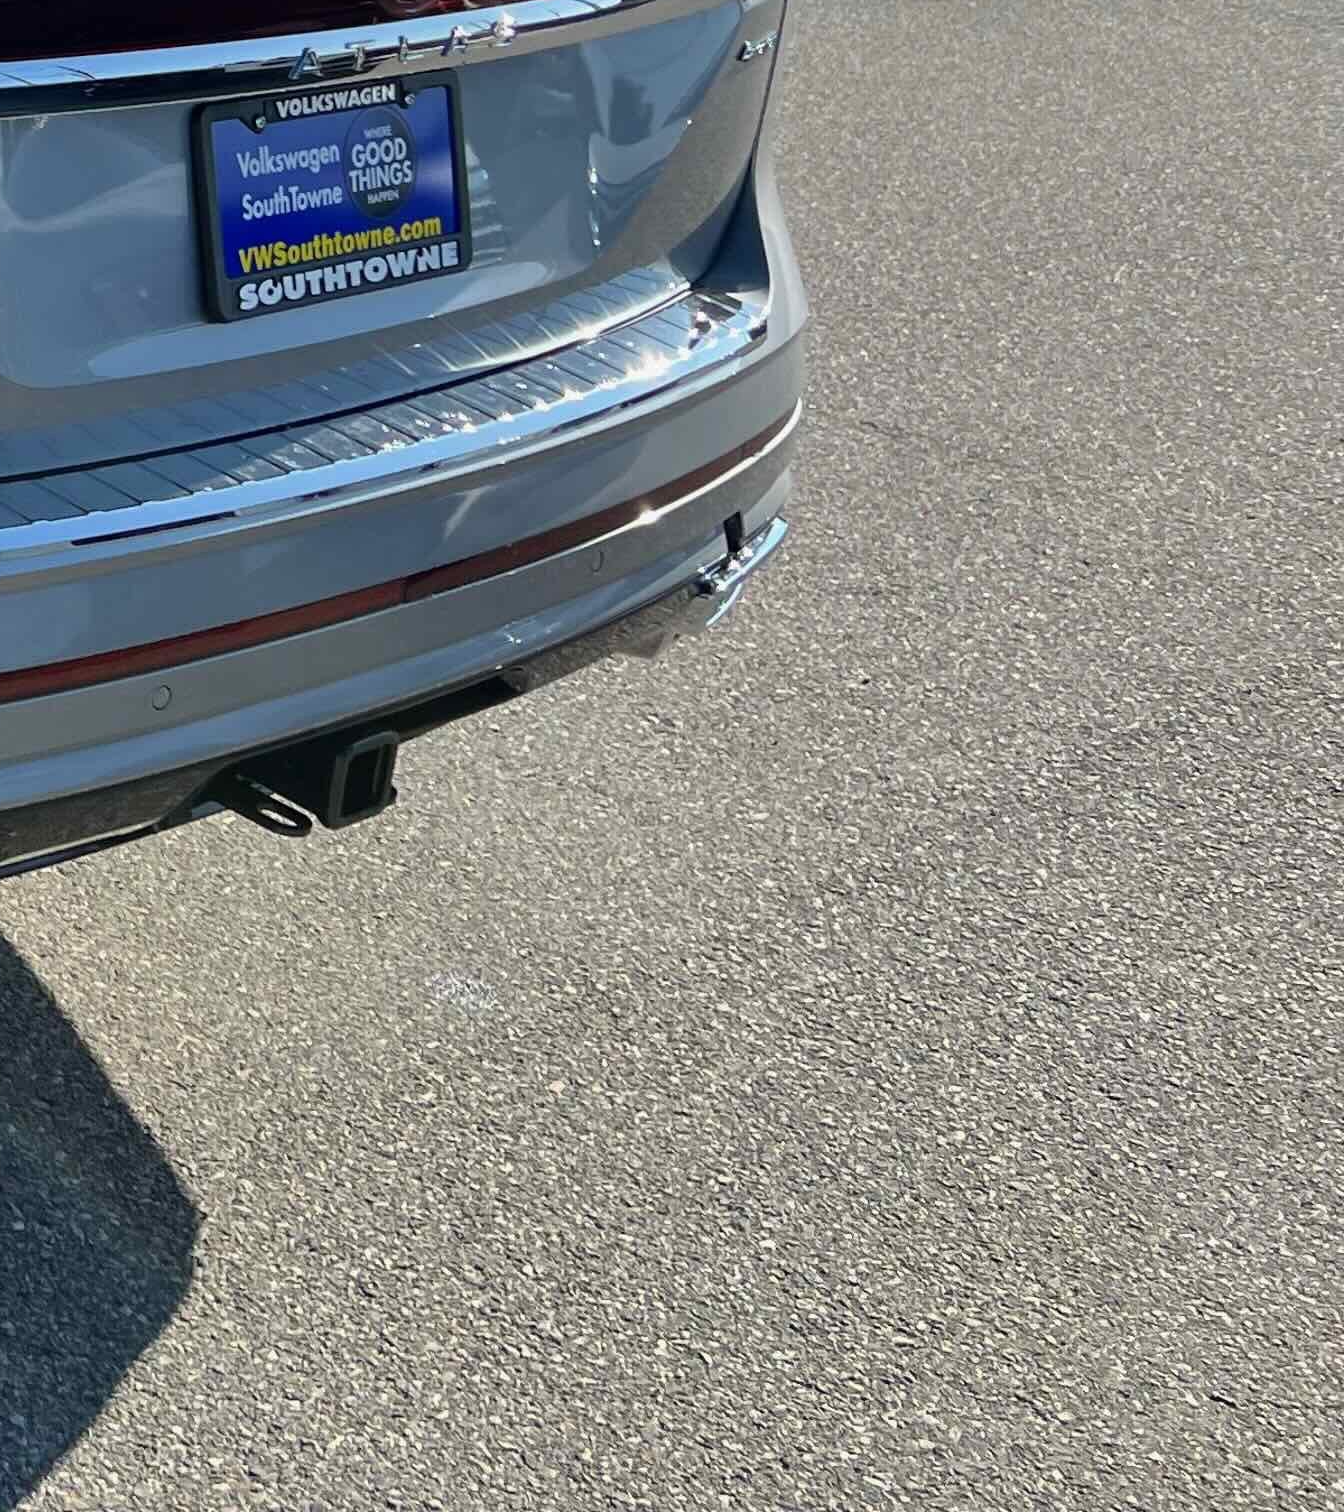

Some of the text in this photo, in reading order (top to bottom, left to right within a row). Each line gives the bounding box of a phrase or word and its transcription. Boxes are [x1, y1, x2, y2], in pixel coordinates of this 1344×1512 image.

[276, 84, 396, 119] VOLKSWAGEN
[236, 143, 340, 179] Volkswagen
[351, 137, 408, 168] GOOD
[348, 159, 413, 193] THINGS
[242, 185, 343, 221] SouthTowne
[238, 216, 442, 273] VWSouthtowne.com
[238, 241, 459, 312] SOUTHTOWNE
